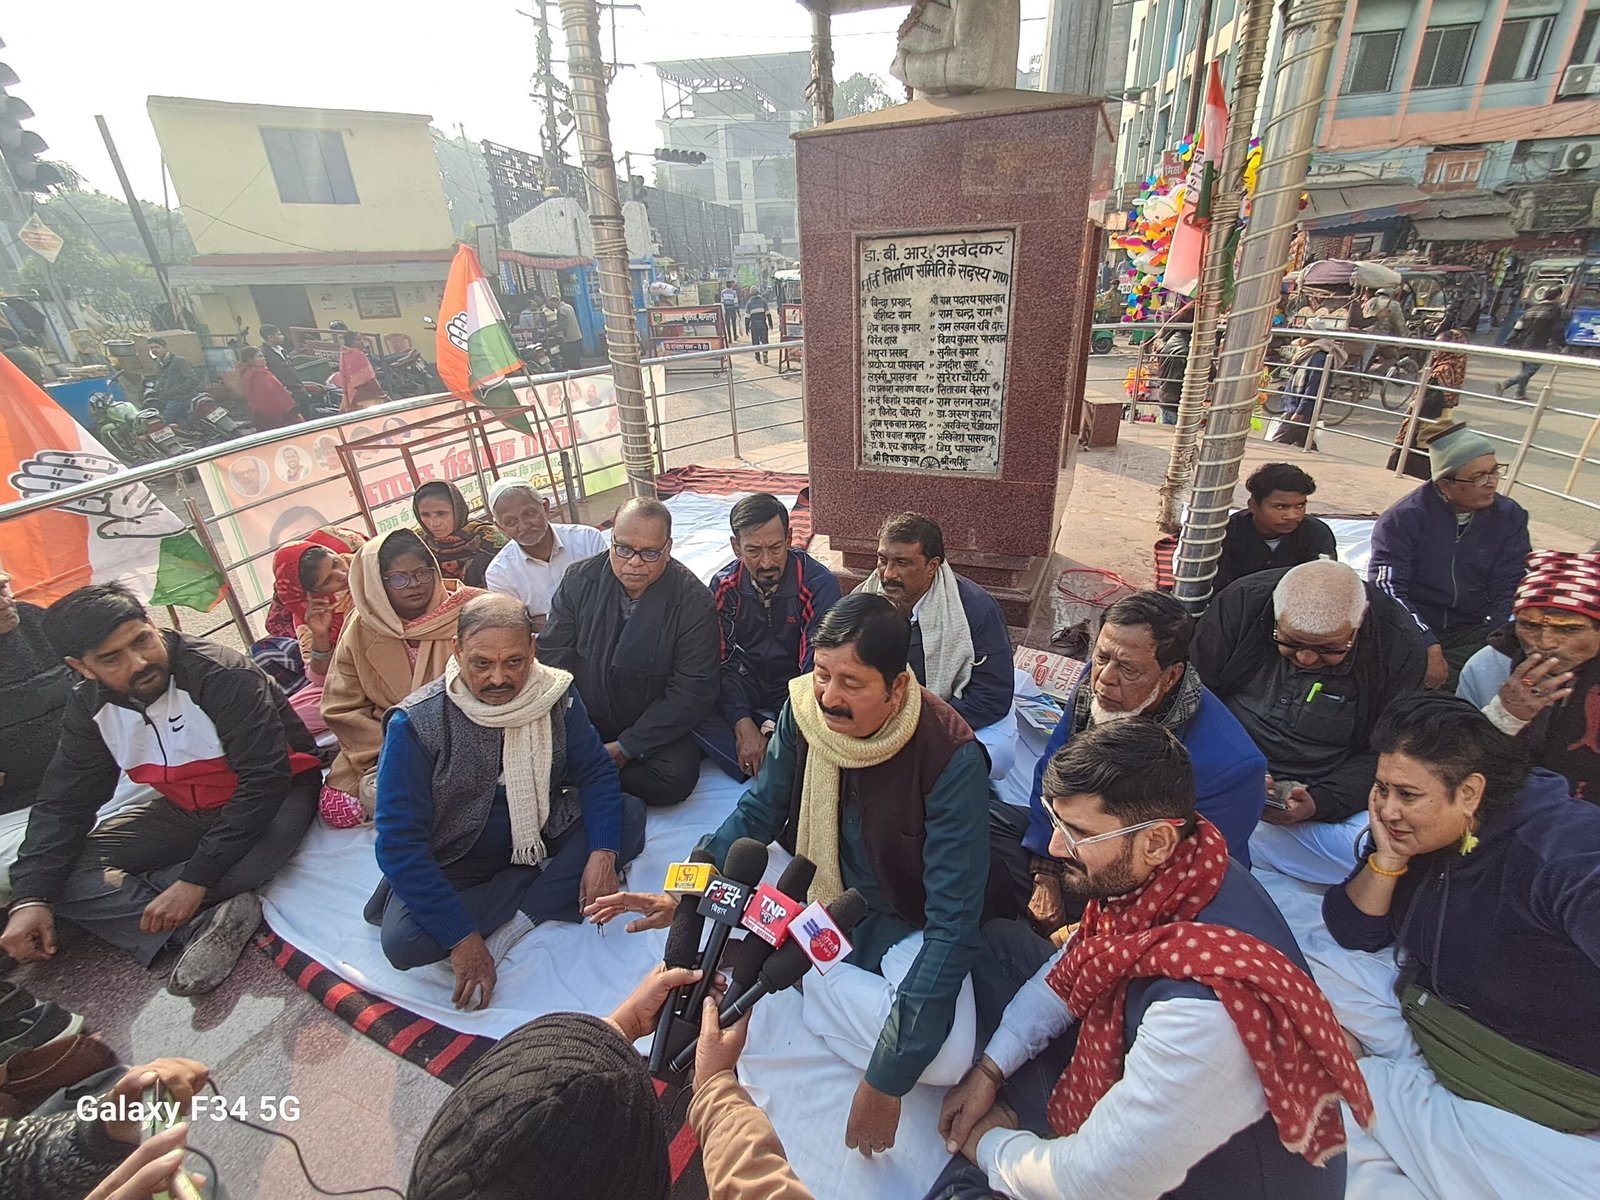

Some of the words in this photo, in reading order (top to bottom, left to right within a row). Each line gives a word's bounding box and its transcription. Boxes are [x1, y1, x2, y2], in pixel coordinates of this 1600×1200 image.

[883, 243, 900, 261] बी.
[936, 239, 1006, 258] अम्बेदकर
[882, 263, 915, 285] निर्माण
[916, 260, 947, 279] समिति
[947, 259, 956, 277] के
[958, 264, 992, 283] सदस्य
[992, 270, 1009, 286] गण
[898, 311, 912, 319] राम
[938, 309, 953, 319] राम
[977, 308, 993, 317] राम
[938, 322, 952, 332] राम
[936, 398, 951, 407] राम
[974, 398, 991, 407] राम
[760, 894, 787, 919] TNP
